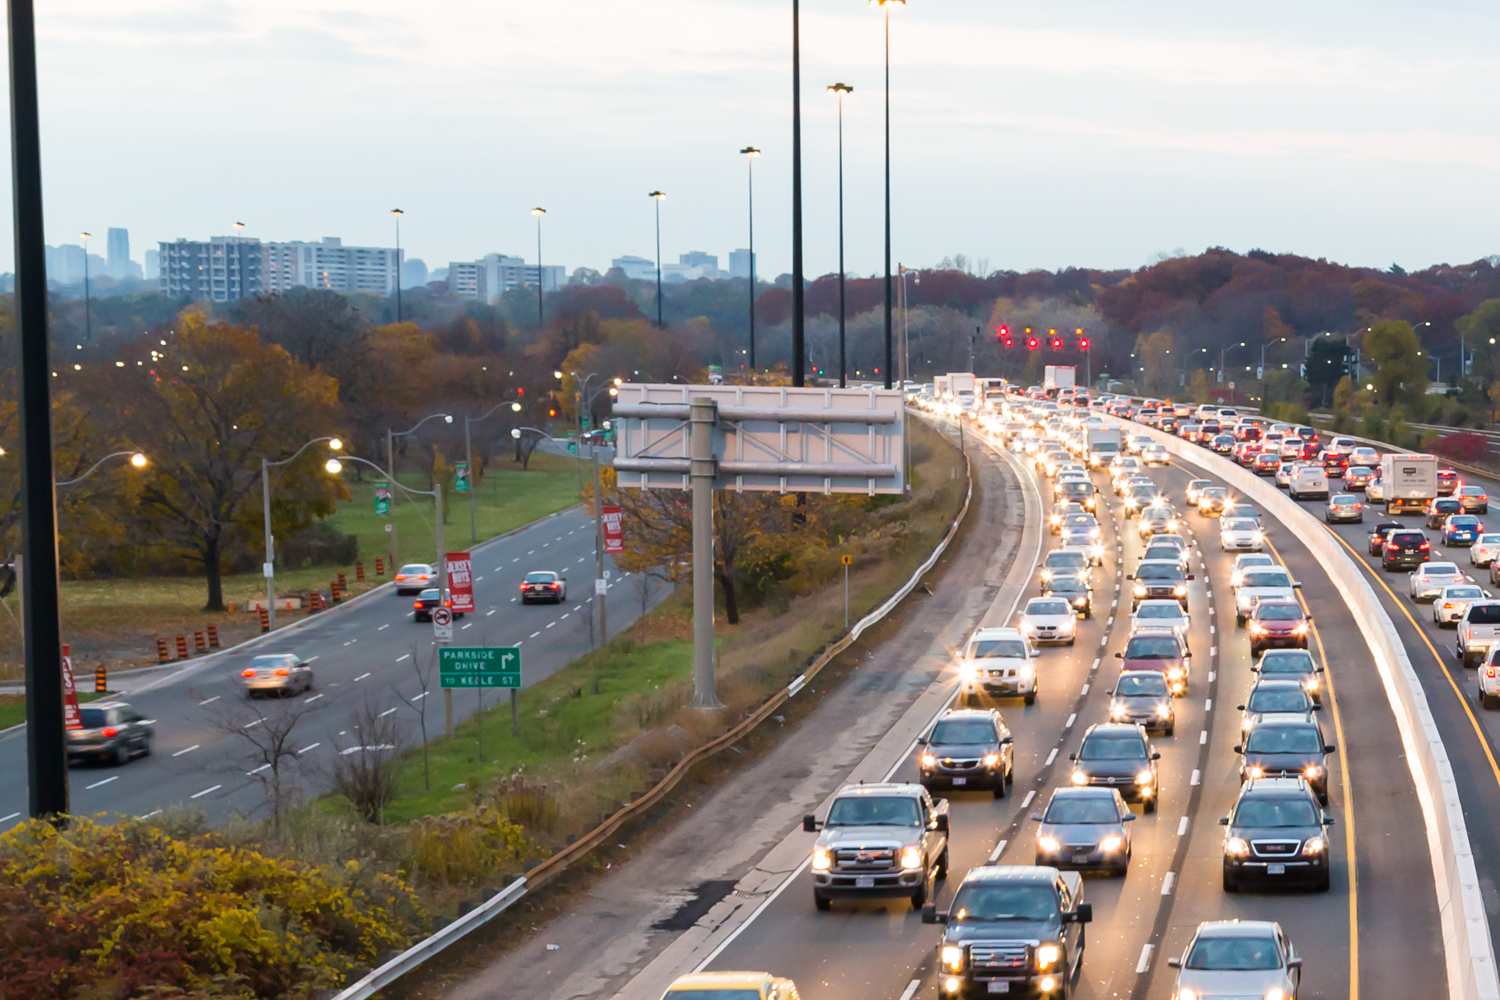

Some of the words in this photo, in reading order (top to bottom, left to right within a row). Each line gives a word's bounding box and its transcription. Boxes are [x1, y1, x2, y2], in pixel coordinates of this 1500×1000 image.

[443, 651, 495, 660] PARKSIDE
[454, 662, 486, 670] DRIVE
[444, 677, 455, 685] TO
[502, 676, 517, 685] ST.
